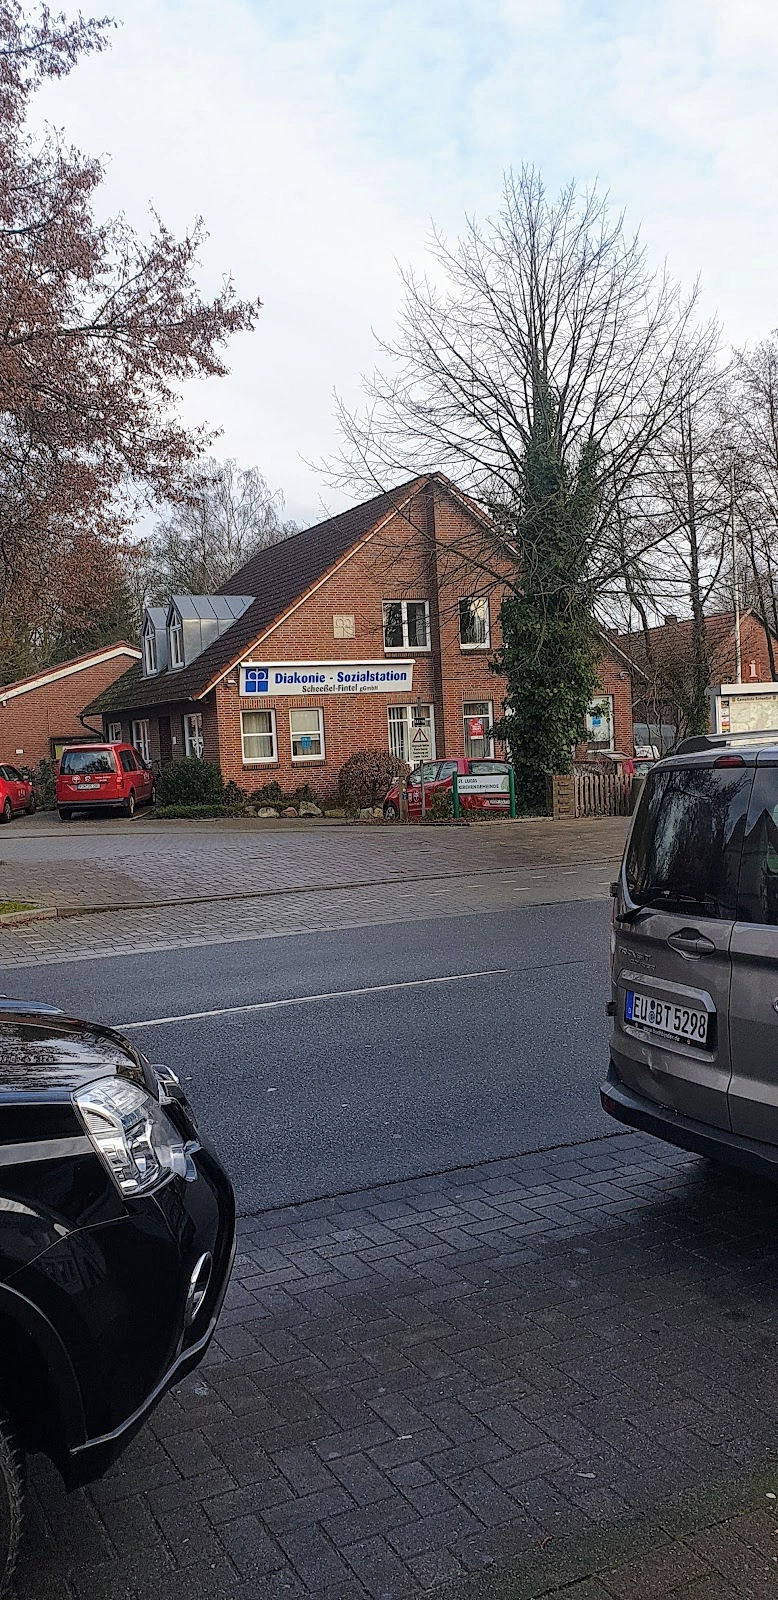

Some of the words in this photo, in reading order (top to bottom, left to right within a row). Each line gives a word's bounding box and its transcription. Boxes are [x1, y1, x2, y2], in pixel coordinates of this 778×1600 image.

[275, 672, 326, 684] Diakonie
[336, 670, 407, 683] Sozialstation
[302, 684, 358, 693] Scheeßel-Fintel
[633, 996, 648, 1021] EU
[655, 1002, 672, 1028] BT
[673, 1007, 706, 1038] 5298
